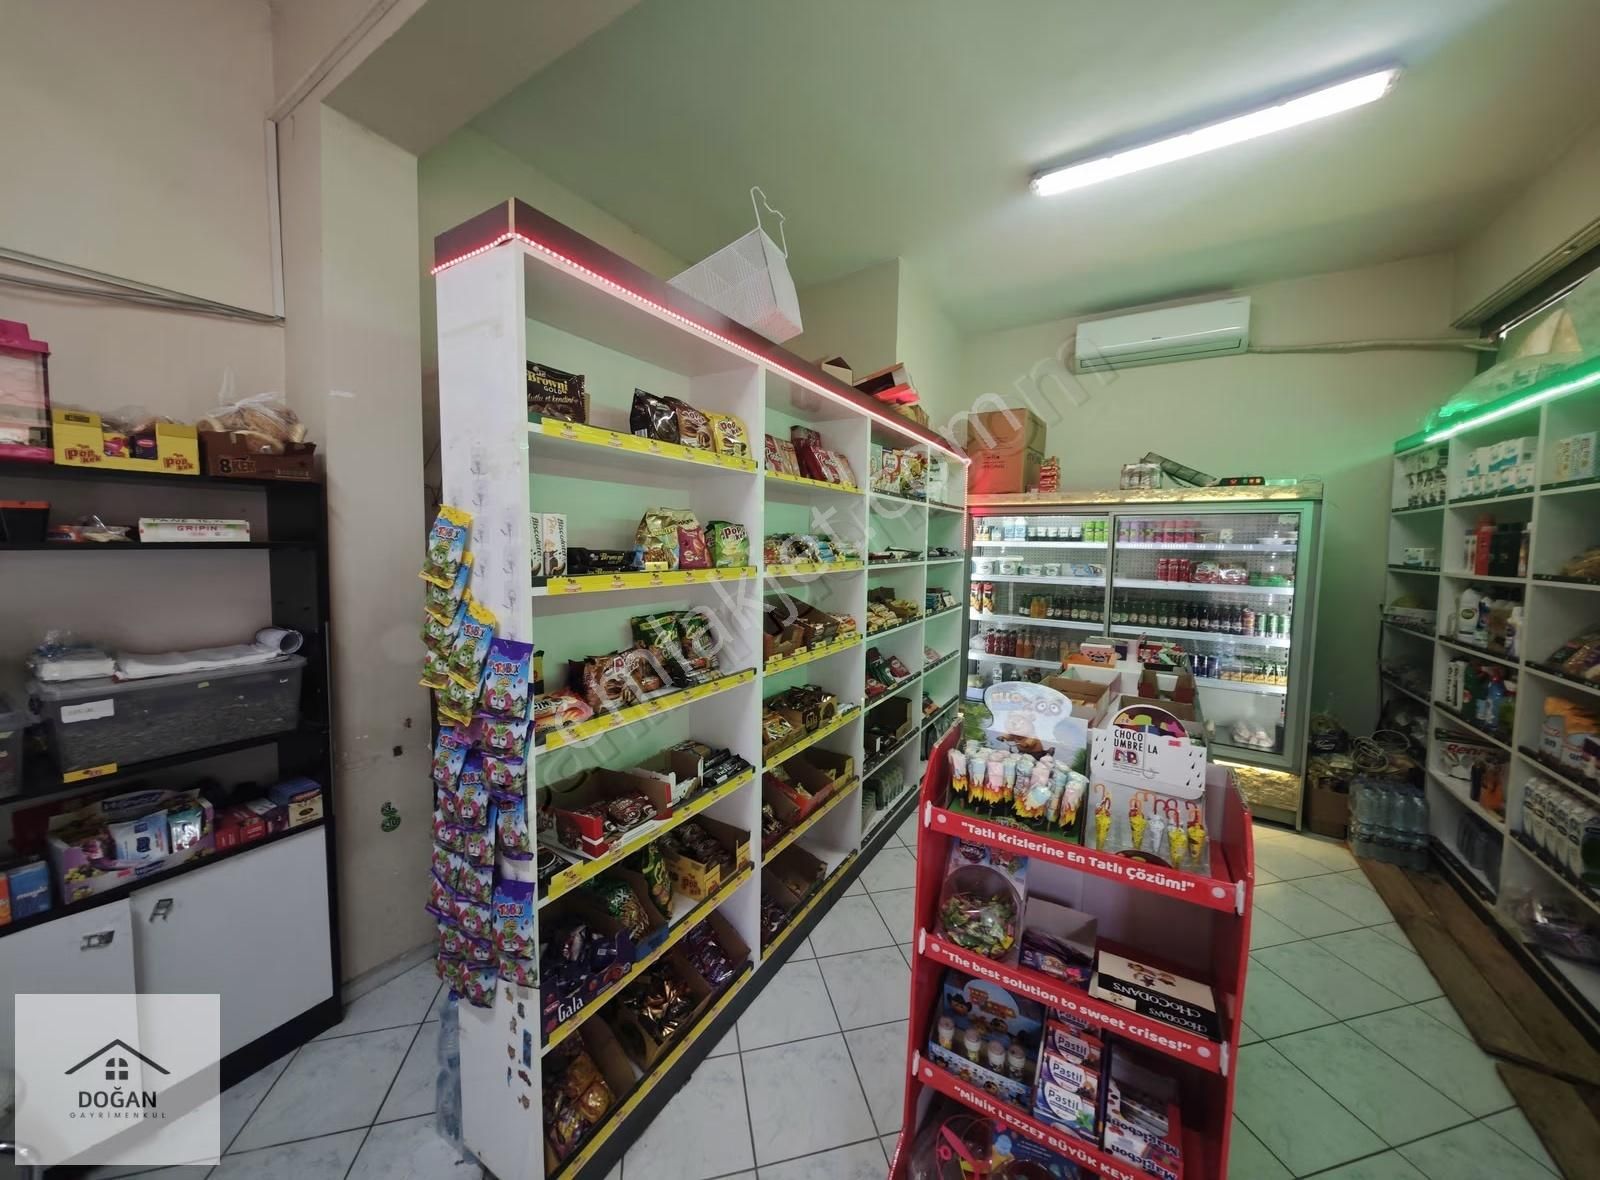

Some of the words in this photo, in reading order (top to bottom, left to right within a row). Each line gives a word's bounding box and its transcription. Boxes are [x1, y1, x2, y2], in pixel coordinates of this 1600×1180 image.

[543, 385, 563, 395] GOLD
[1114, 729, 1143, 742] CHOCO
[997, 832, 1065, 859] Krizlerine
[1067, 851, 1086, 864] En
[1088, 856, 1123, 874] Tatlı
[557, 995, 584, 1023] Gala
[972, 961, 1001, 981] best
[1002, 975, 1059, 1004] solution
[1060, 998, 1077, 1010] to
[1079, 1005, 1127, 1030] sweet
[1113, 982, 1201, 1018] CHOCODANS
[1148, 1007, 1208, 1033] CHOCODANS
[998, 1110, 1046, 1140] LEZZET
[1047, 1137, 1097, 1168] BÜYÜK
